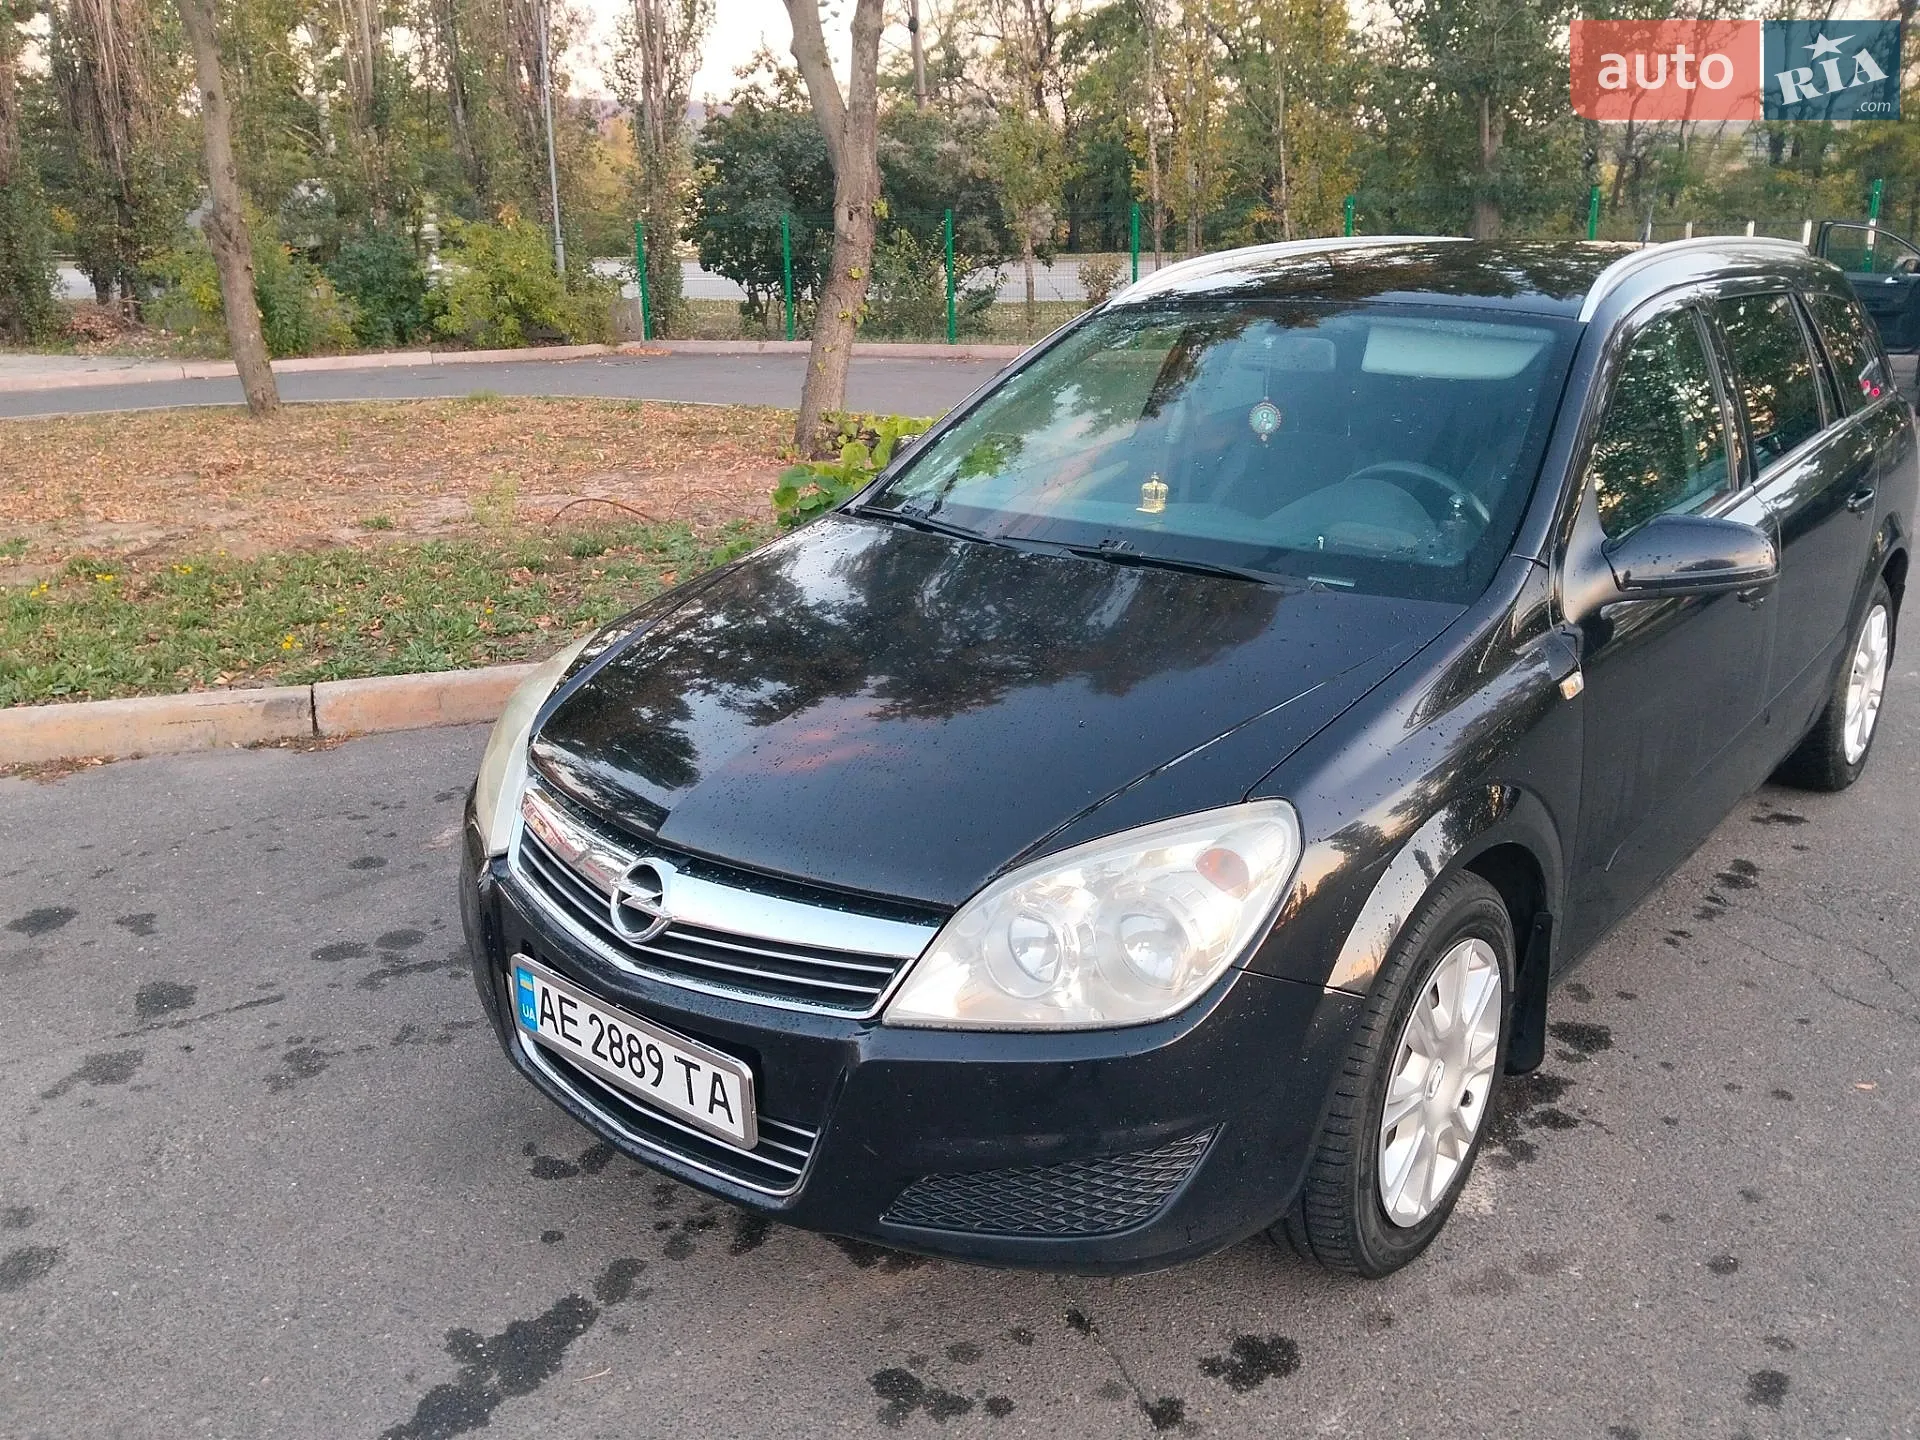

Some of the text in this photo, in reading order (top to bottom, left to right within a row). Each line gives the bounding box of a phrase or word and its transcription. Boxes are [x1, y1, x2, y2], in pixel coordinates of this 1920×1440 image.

[522, 1004, 536, 1022] UA
[540, 987, 734, 1124] AE 2889 TA
